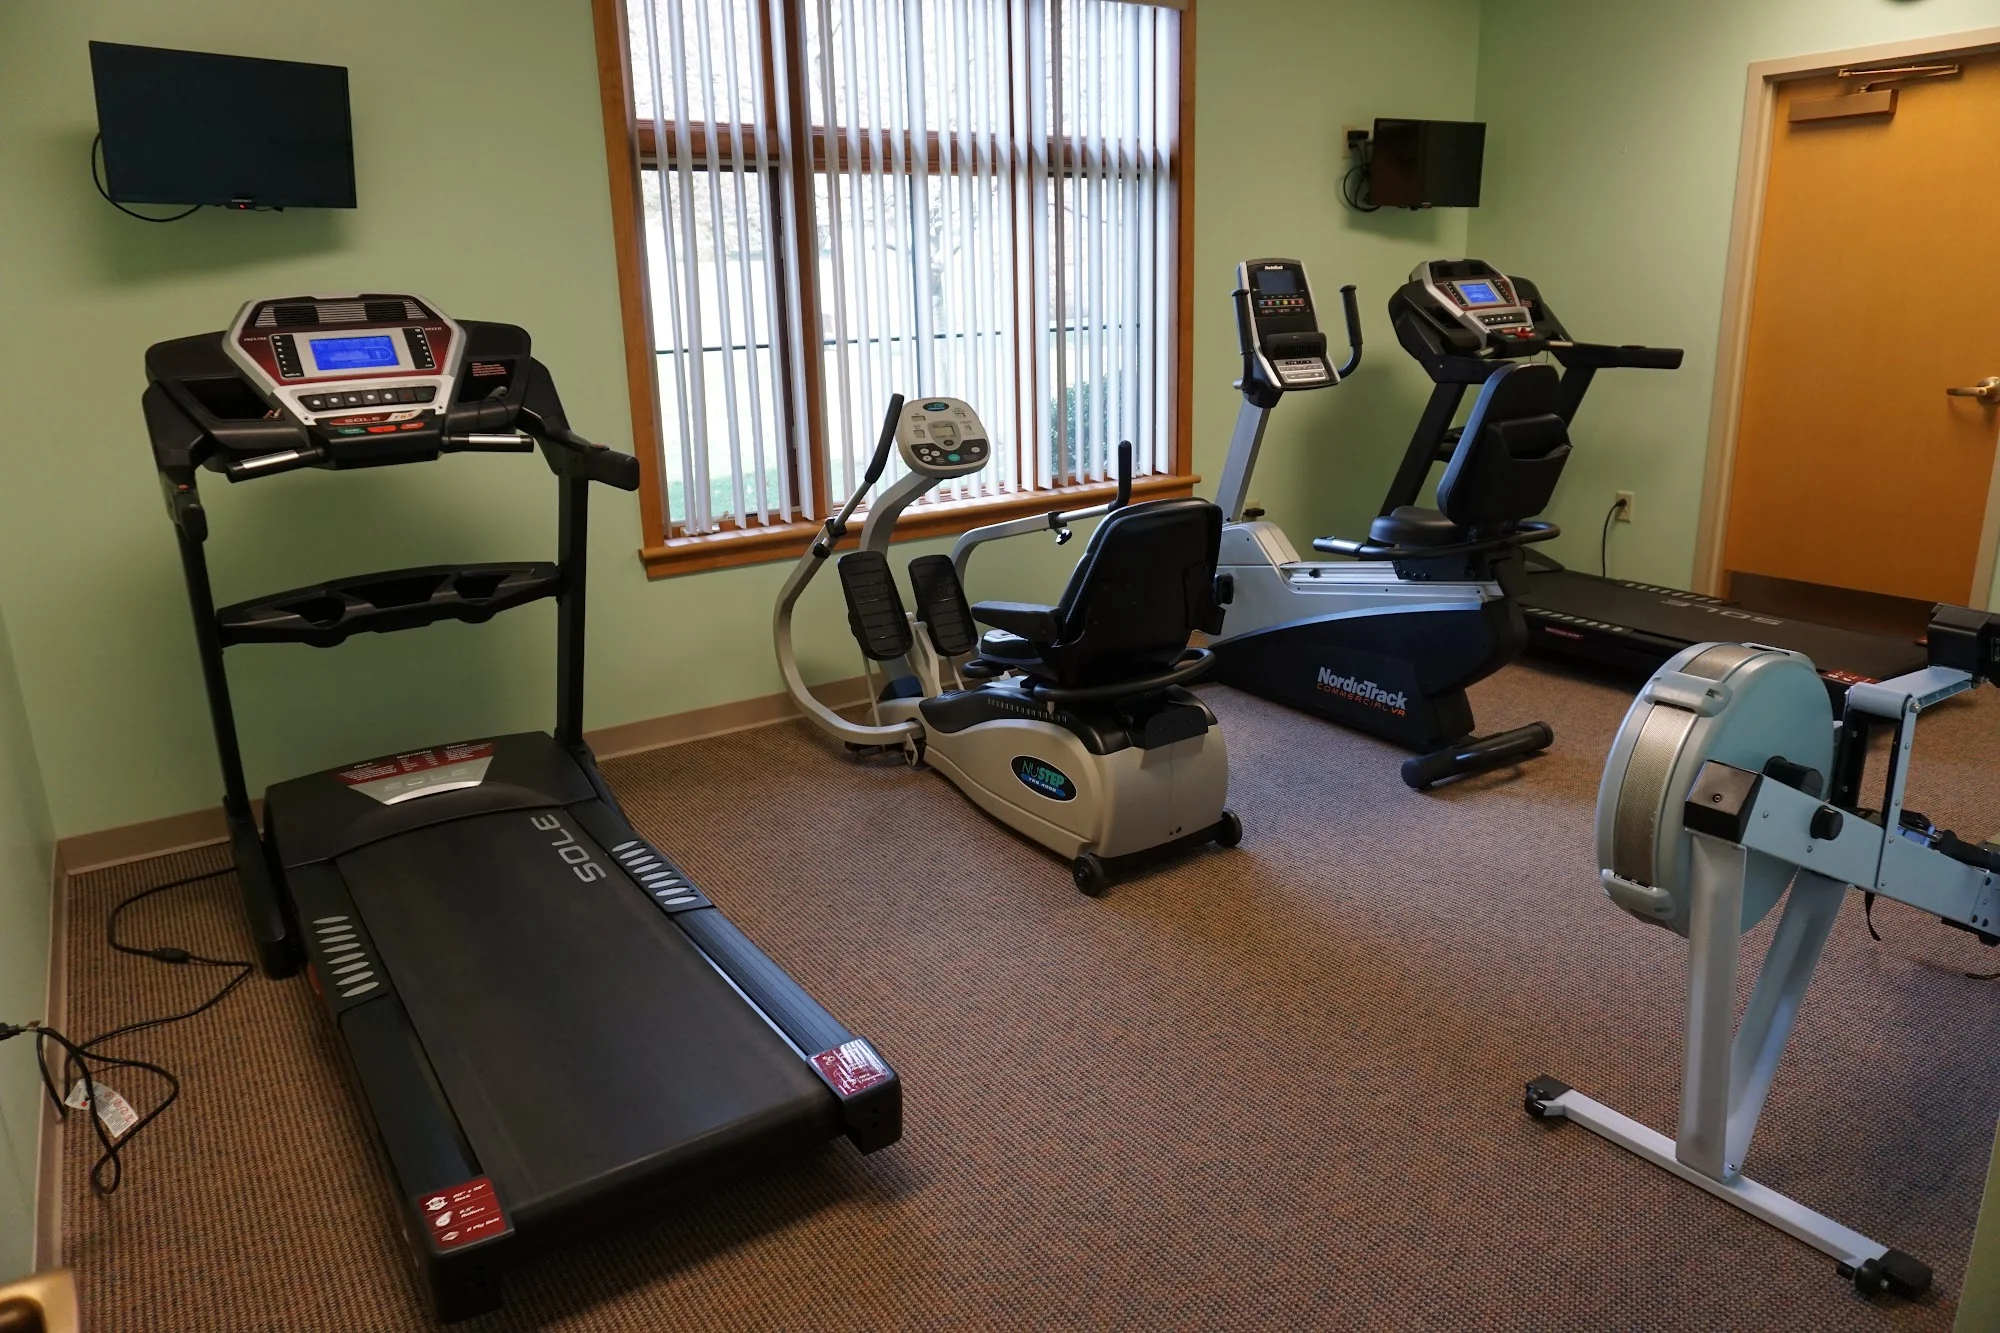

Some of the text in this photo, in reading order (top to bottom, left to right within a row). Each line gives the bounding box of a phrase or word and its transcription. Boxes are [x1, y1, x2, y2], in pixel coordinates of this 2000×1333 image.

[1661, 599, 1783, 625] SOLE
[1317, 683, 1406, 717] COMMERCIAL VR
[1318, 666, 1408, 710] NordicTrack
[1029, 777, 1039, 785] TRS
[530, 814, 606, 882] SOLE
